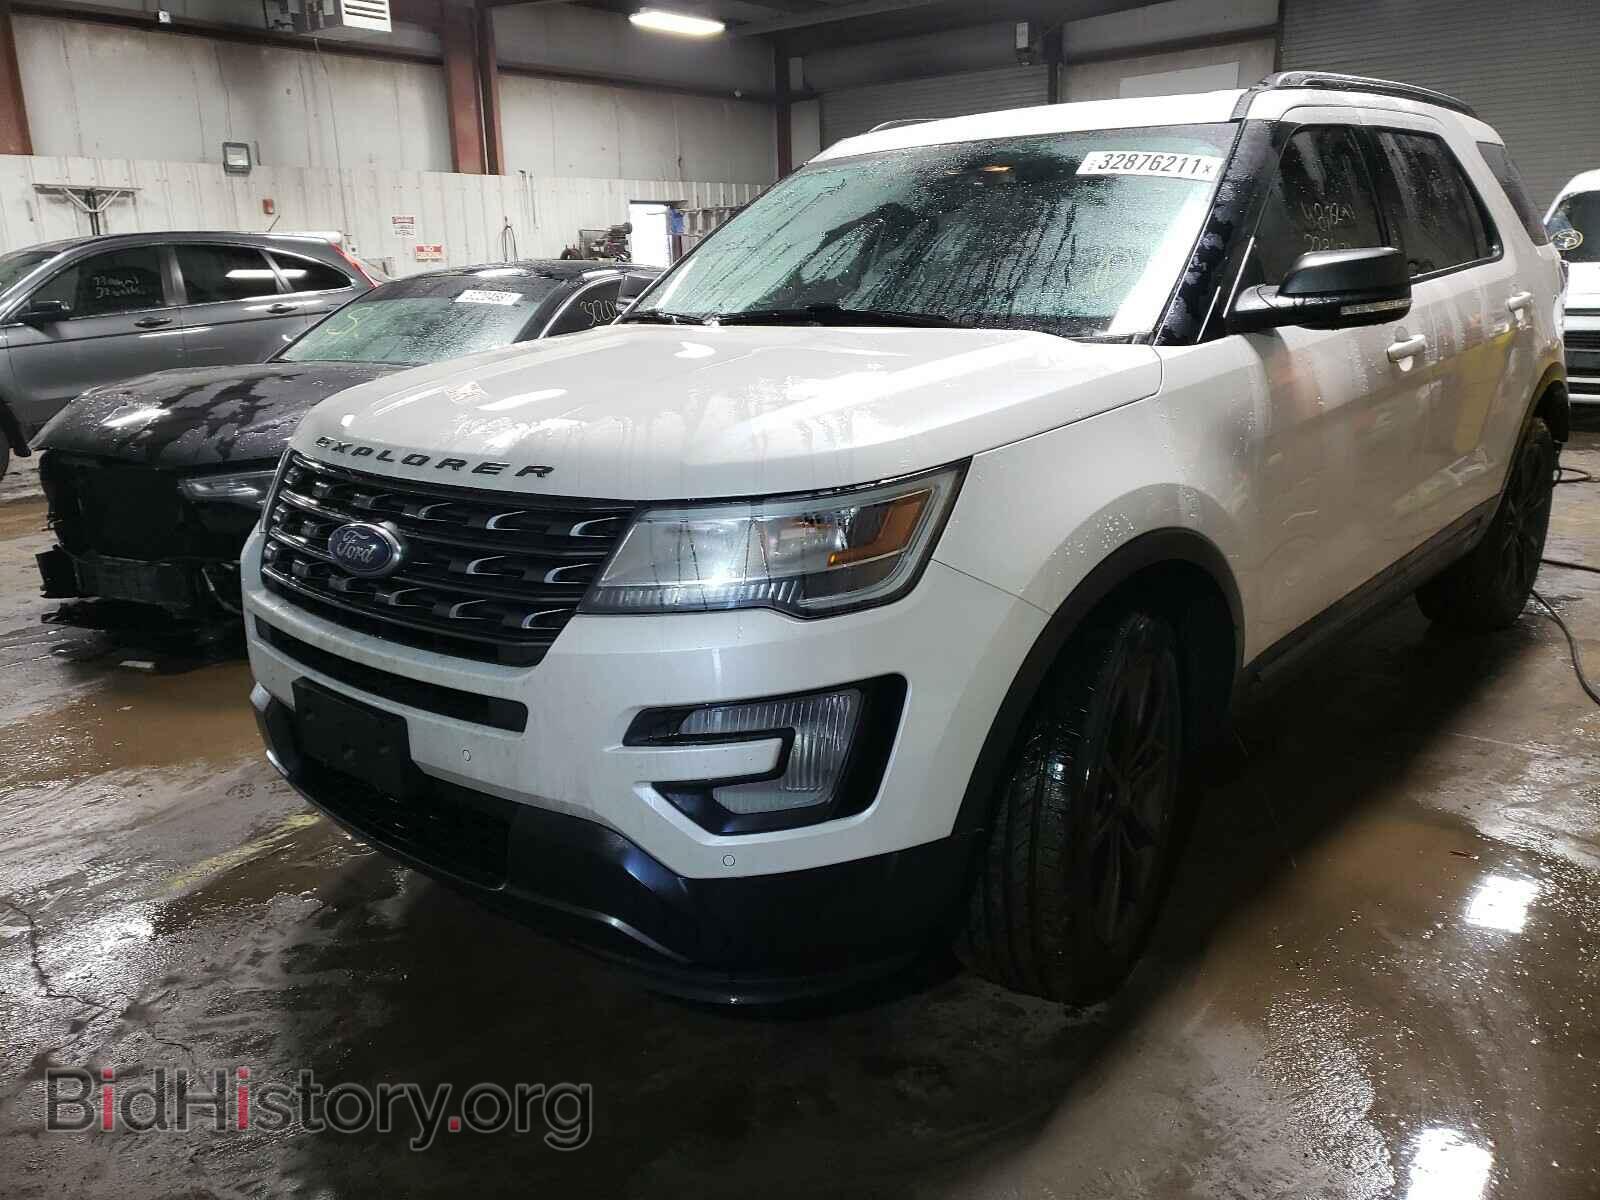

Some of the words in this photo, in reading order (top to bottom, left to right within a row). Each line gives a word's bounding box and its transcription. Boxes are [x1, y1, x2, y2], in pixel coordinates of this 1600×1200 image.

[1098, 153, 1202, 174] 32876211
[315, 436, 554, 478] EXPLORER
[337, 530, 376, 563] Ford
